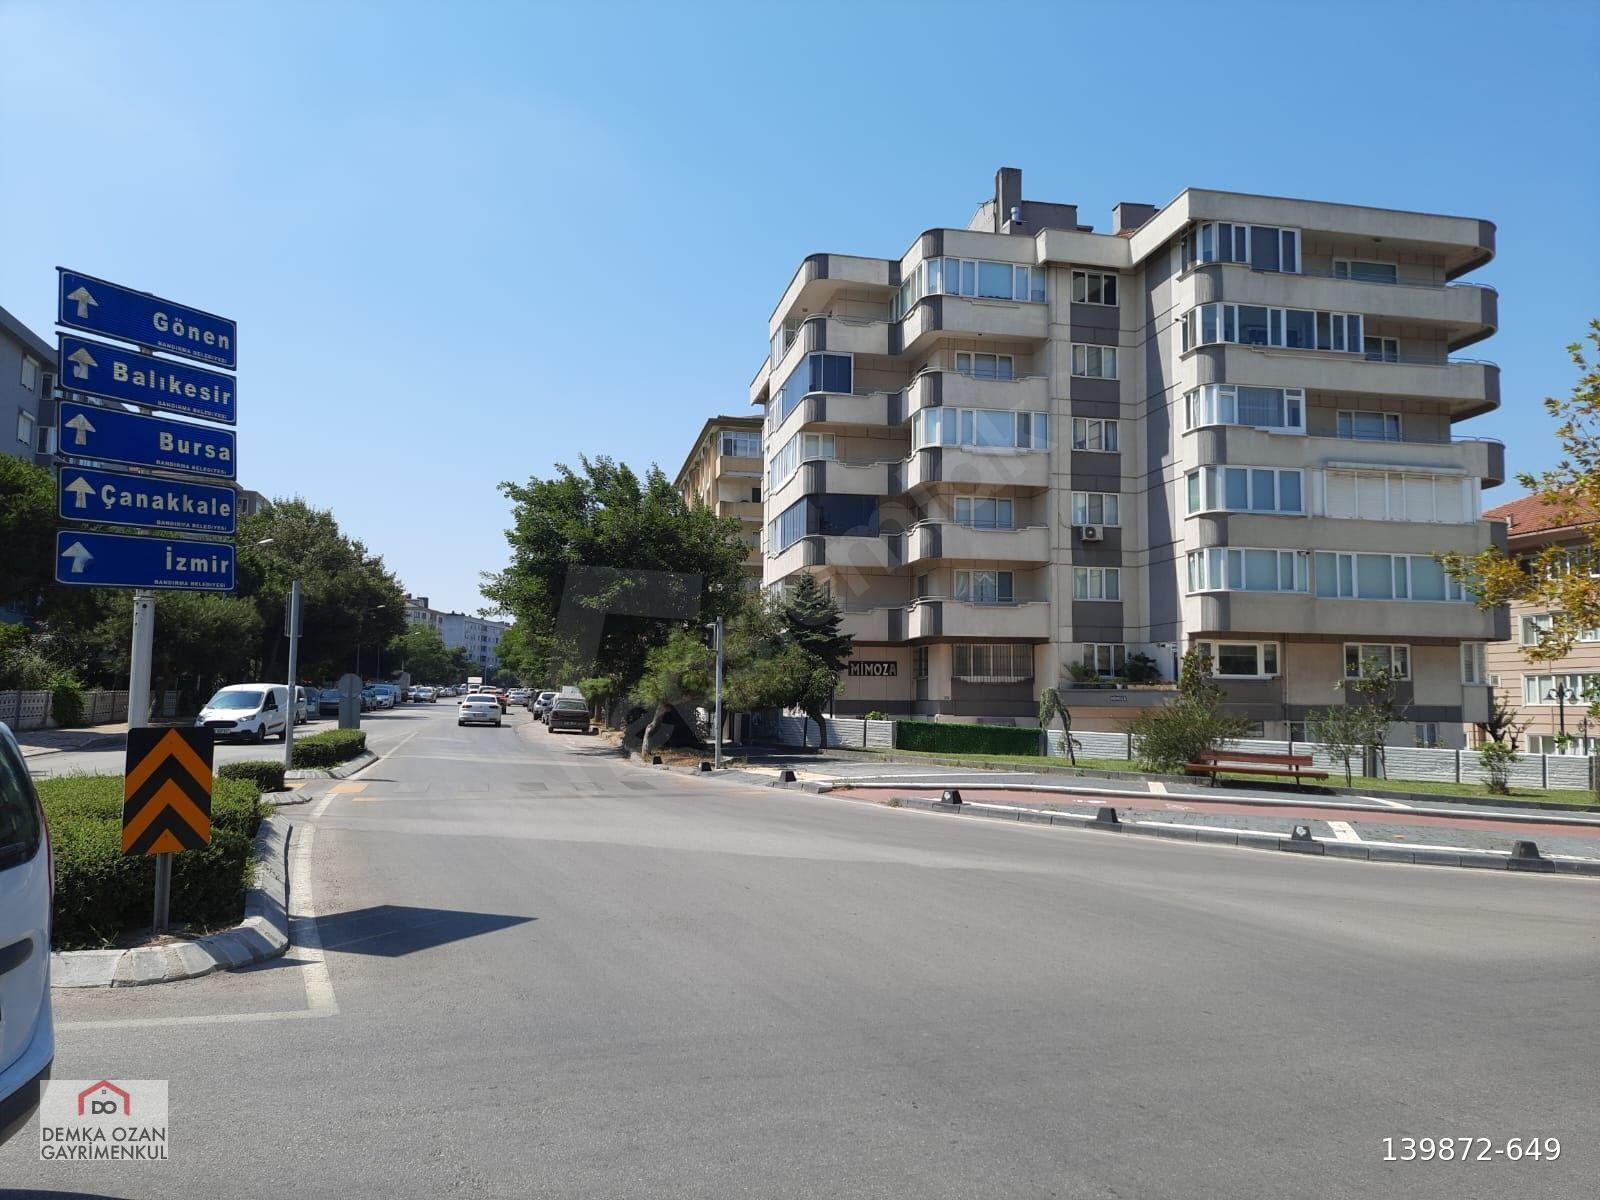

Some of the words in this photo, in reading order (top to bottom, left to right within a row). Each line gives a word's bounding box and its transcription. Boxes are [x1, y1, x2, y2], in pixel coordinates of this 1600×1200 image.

[153, 312, 230, 350] Gönen
[113, 361, 231, 405] Balıkesir
[159, 431, 231, 461] Bursa
[101, 484, 231, 517] Çanakkale
[166, 546, 229, 574] İzmir
[850, 661, 897, 676] MİMOZA
